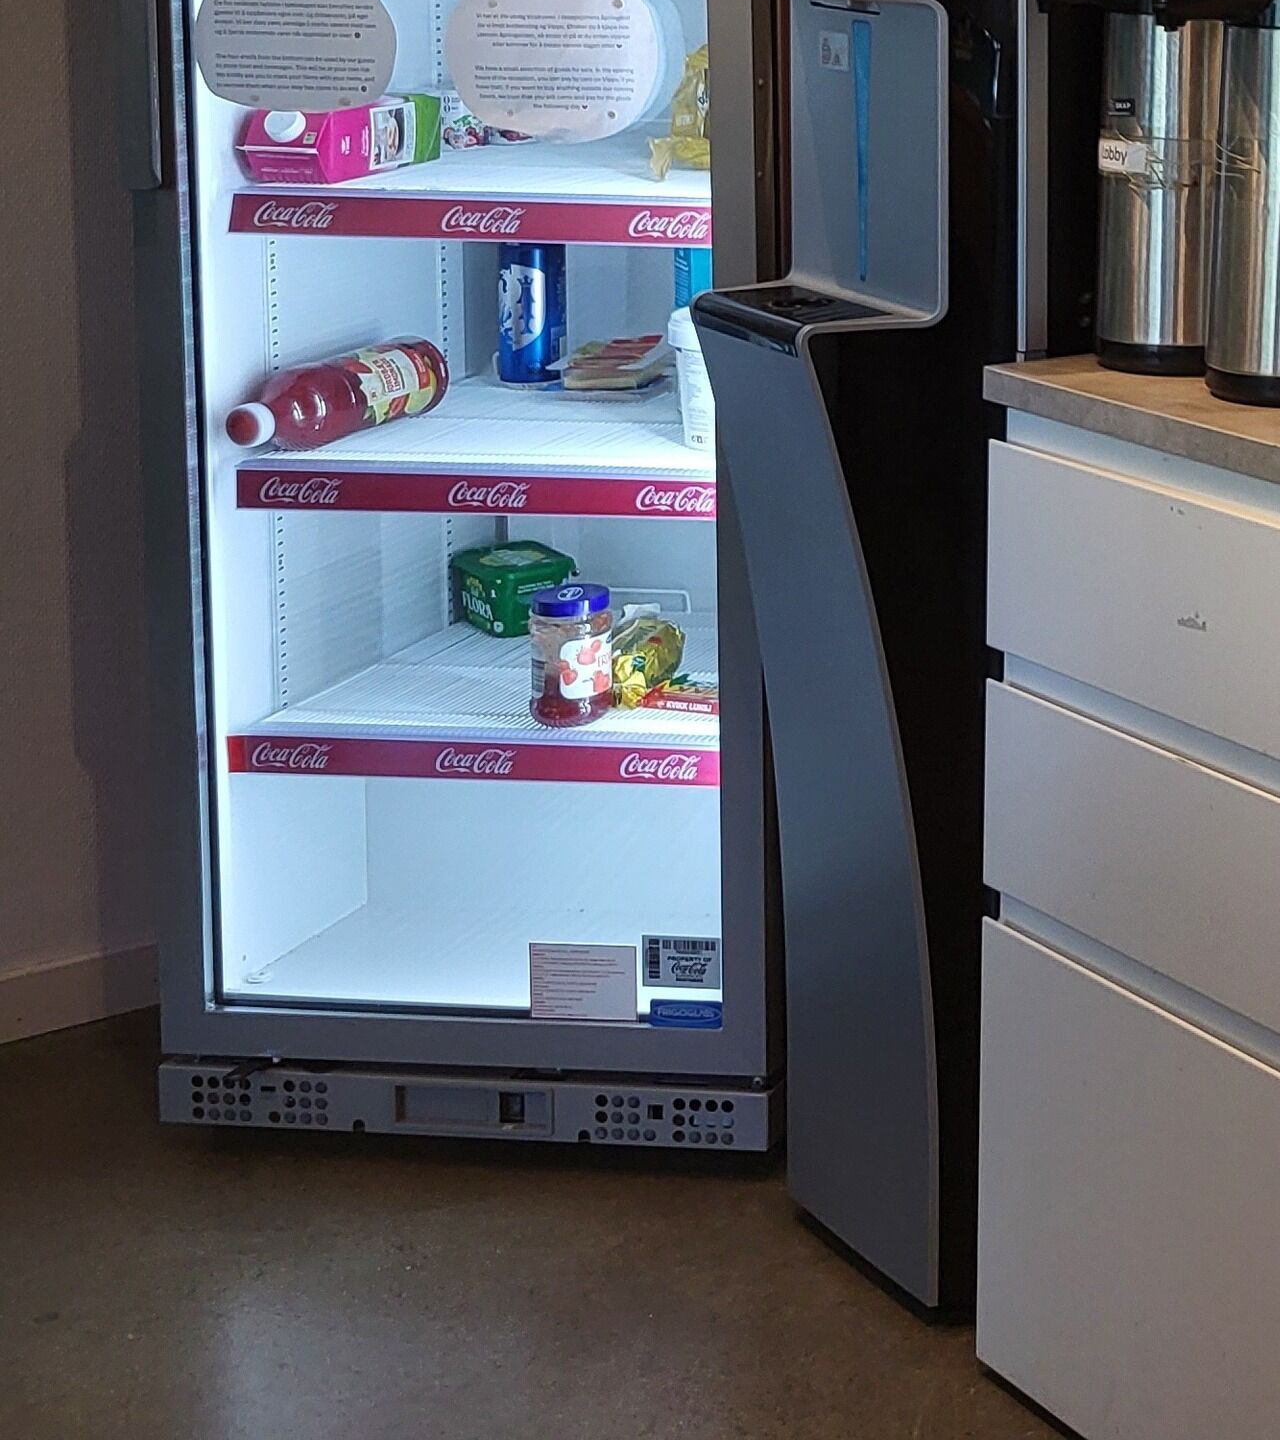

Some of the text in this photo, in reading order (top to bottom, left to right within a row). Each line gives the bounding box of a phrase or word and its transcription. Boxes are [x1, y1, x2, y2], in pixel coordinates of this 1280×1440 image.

[253, 200, 339, 229] Coca-Cola
[441, 205, 527, 235] Coca-Cola
[628, 209, 712, 240] Coca-Cola
[259, 476, 342, 505] Coca-Cola
[448, 480, 530, 510] Coca-Cola
[635, 485, 716, 514] Coca-Cola
[462, 591, 494, 621] FLORA
[251, 741, 334, 770] Coca-Cola
[434, 747, 517, 776] Coca-Cola
[619, 751, 702, 781] Coca-Cola
